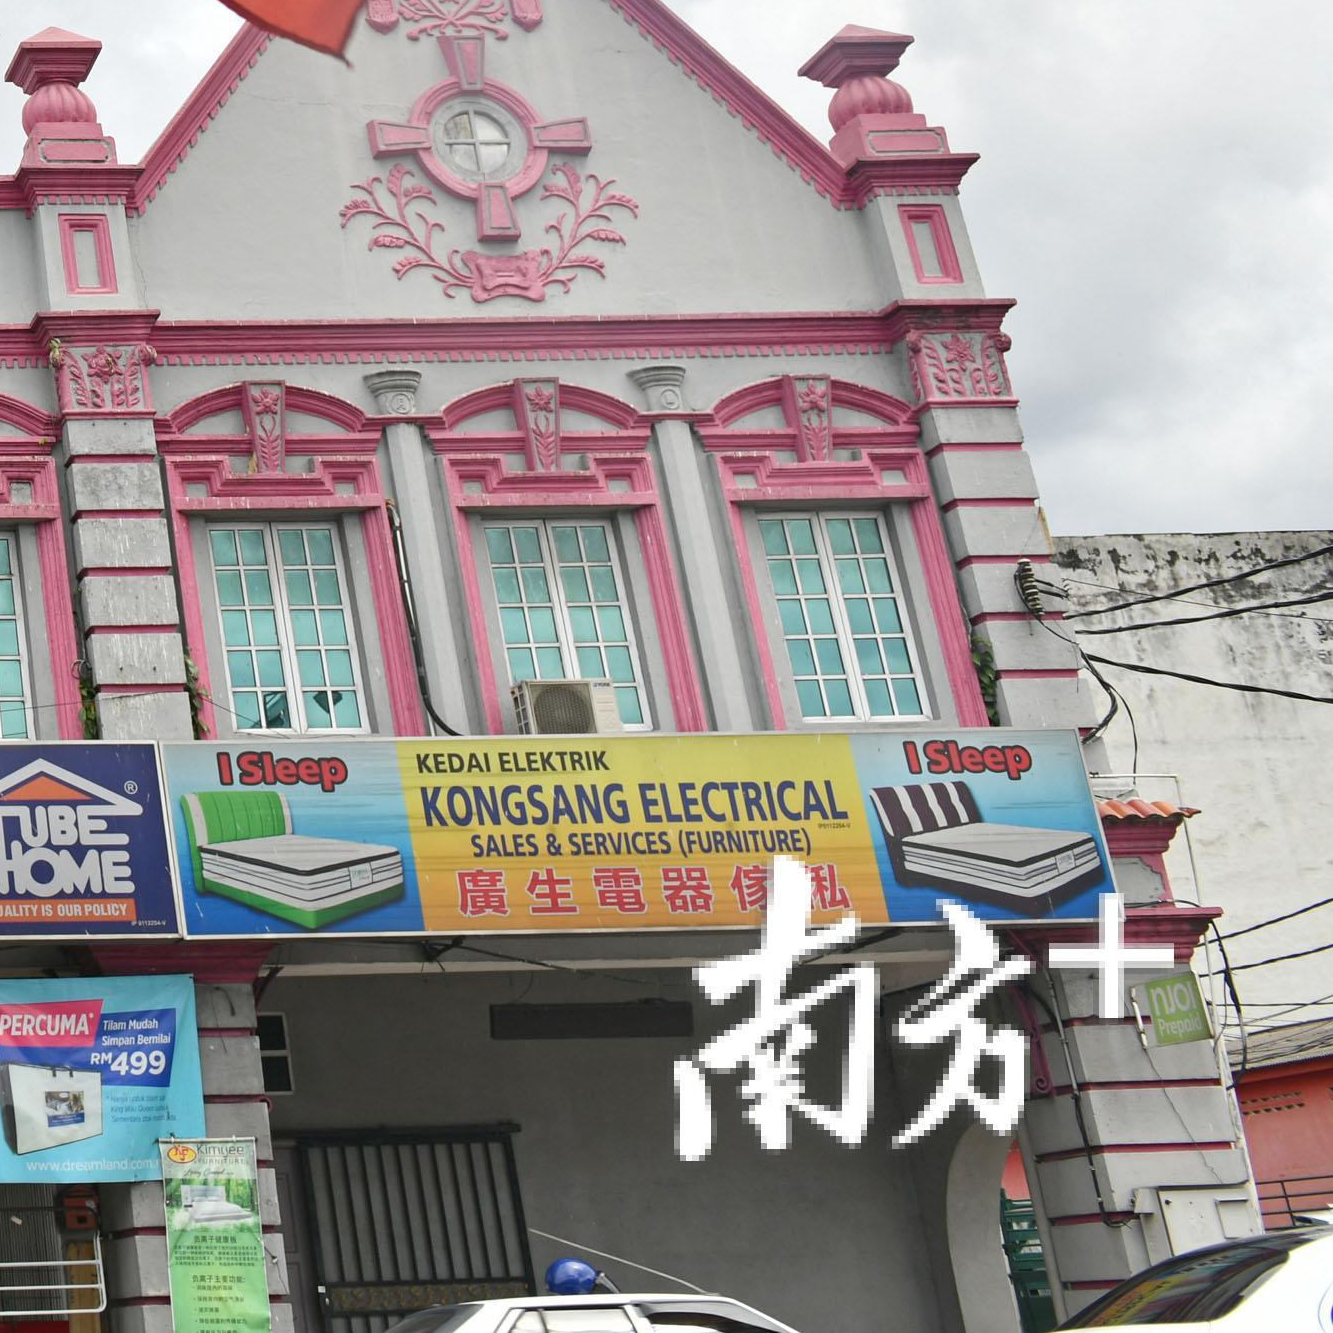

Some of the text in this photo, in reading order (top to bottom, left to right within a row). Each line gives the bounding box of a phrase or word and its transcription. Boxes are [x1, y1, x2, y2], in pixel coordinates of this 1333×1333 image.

[217, 751, 348, 792] I Sleep
[416, 751, 611, 774] KEDAI ELEKTRIK
[903, 740, 1032, 780] I Sleep
[421, 780, 849, 826] KONGSANG ELECTRICAL
[471, 829, 812, 858] SALES & SERVICES (FURNITURE)
[41, 904, 53, 917] IS
[58, 904, 81, 916] OUR
[85, 903, 127, 917] POLICY
[103, 1018, 159, 1031] Tilam Mudah
[1158, 1016, 1201, 1037] Prepaid
[102, 1036, 135, 1047] Simpan
